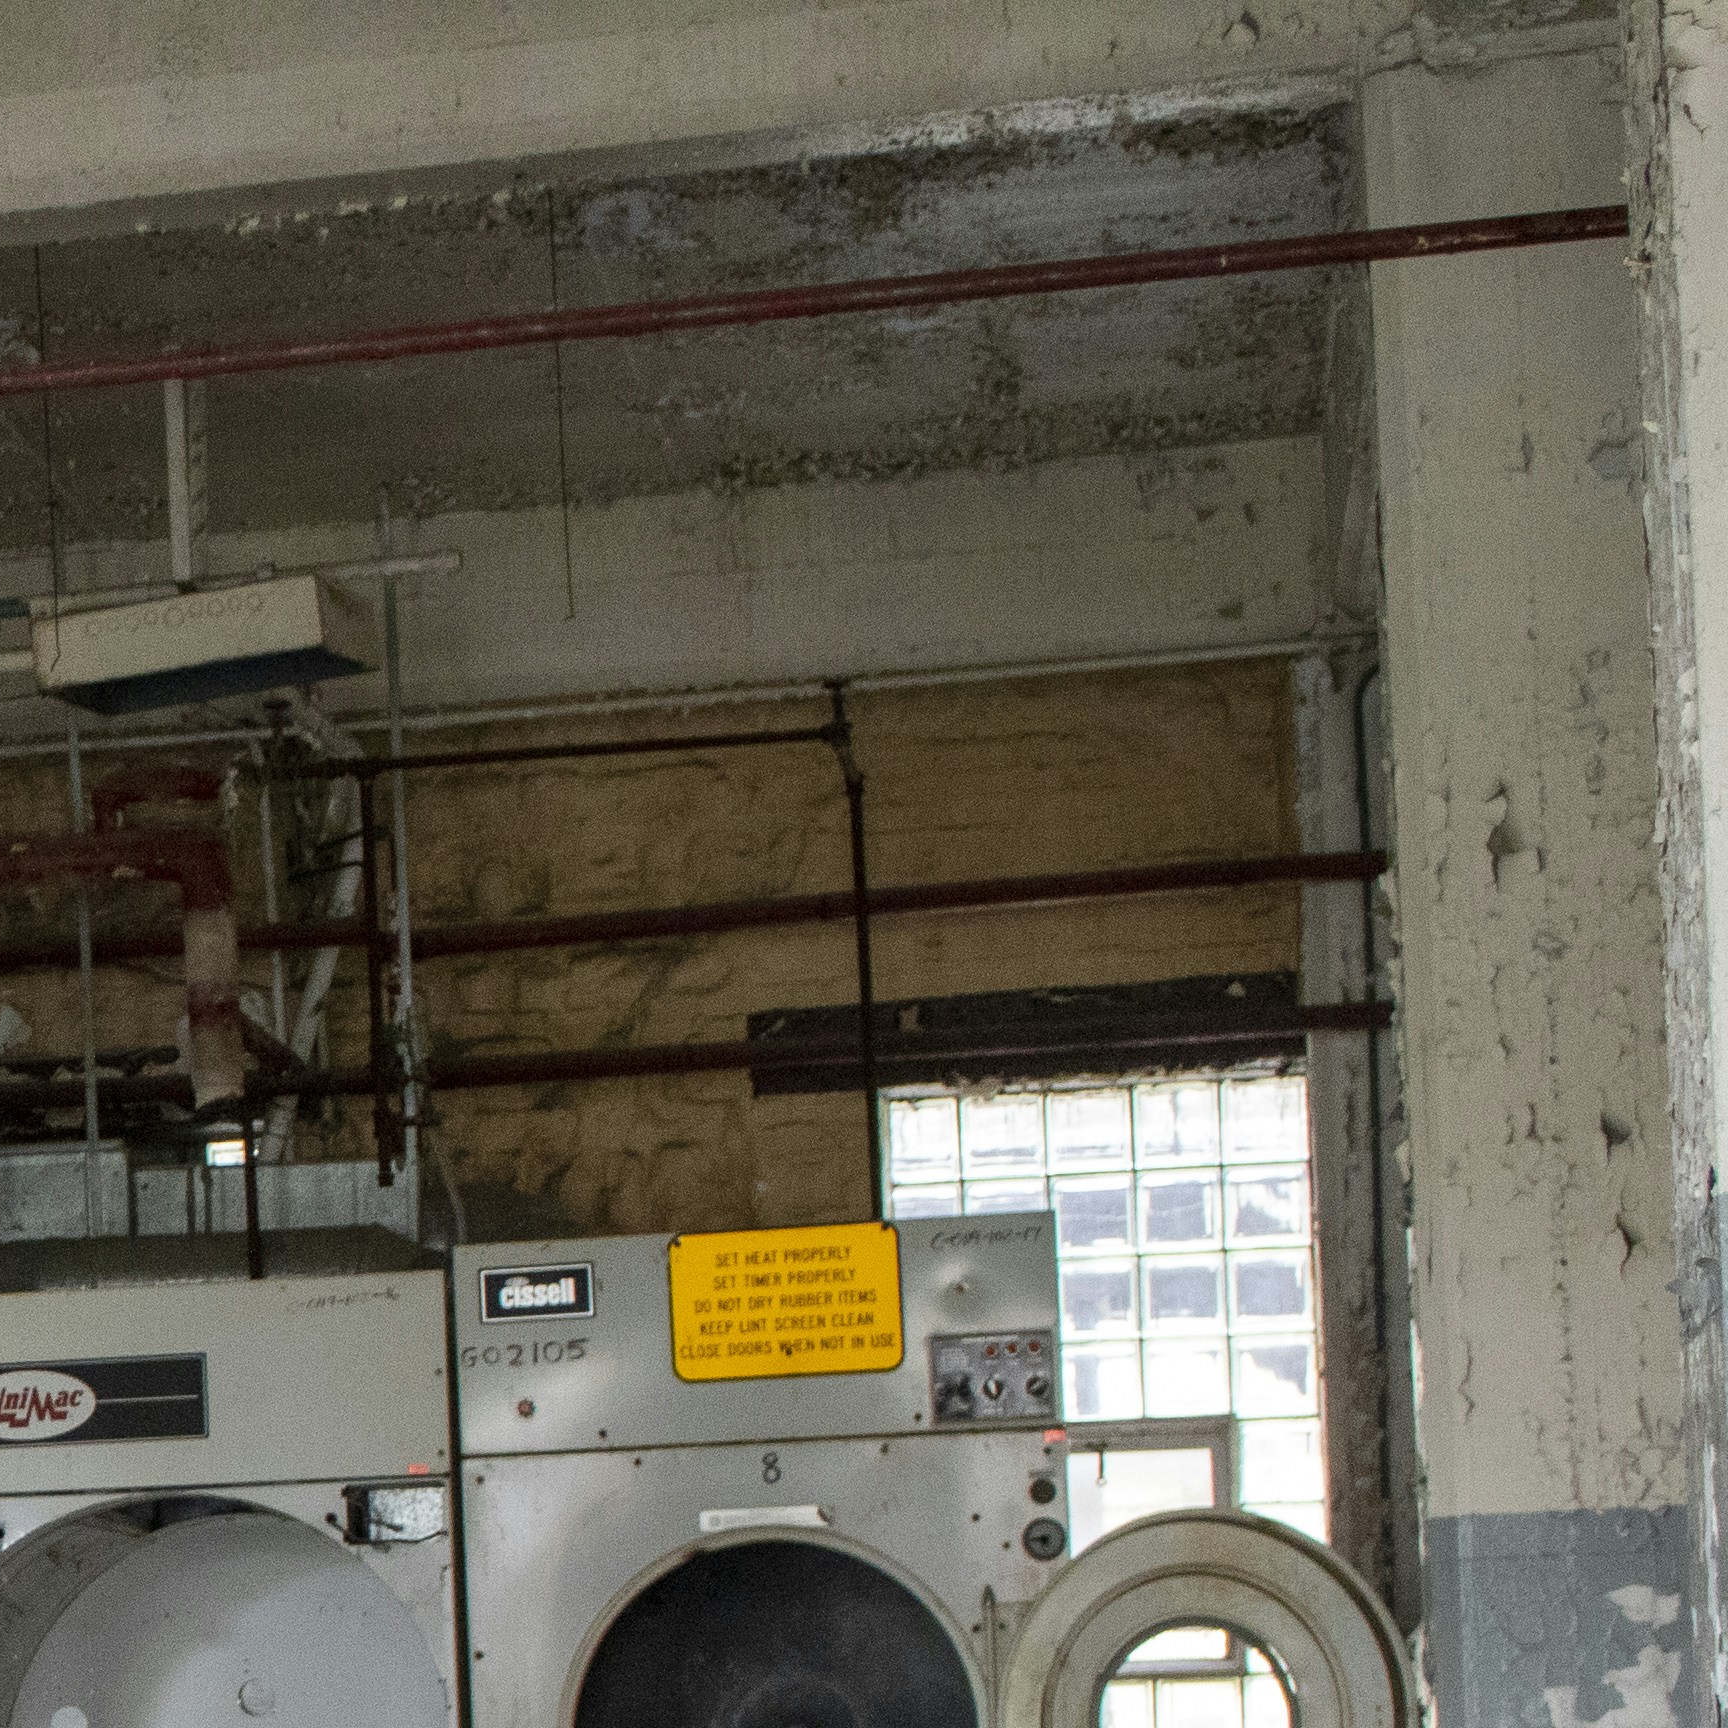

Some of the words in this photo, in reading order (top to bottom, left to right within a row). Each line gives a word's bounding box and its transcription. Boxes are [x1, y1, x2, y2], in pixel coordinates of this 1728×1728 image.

[715, 1252, 739, 1268] SET
[745, 1250, 778, 1266] HEAT
[784, 1246, 851, 1263] PROPERLY
[713, 1276, 736, 1290] SET
[745, 1272, 781, 1288] TIMER
[787, 1268, 856, 1284] PROPERLY
[500, 1277, 576, 1309] cissell
[694, 1300, 713, 1315] DO
[718, 1298, 741, 1313] NOT
[749, 1296, 774, 1311] DRY
[780, 1292, 833, 1308] RUBBER
[838, 1289, 877, 1305] ITEMS
[700, 1321, 734, 1336] KEEP
[739, 1318, 767, 1334] LINT
[774, 1315, 826, 1332] SCREEN
[831, 1312, 874, 1328] CLEAN
[761, 1451, 782, 1484] 8
